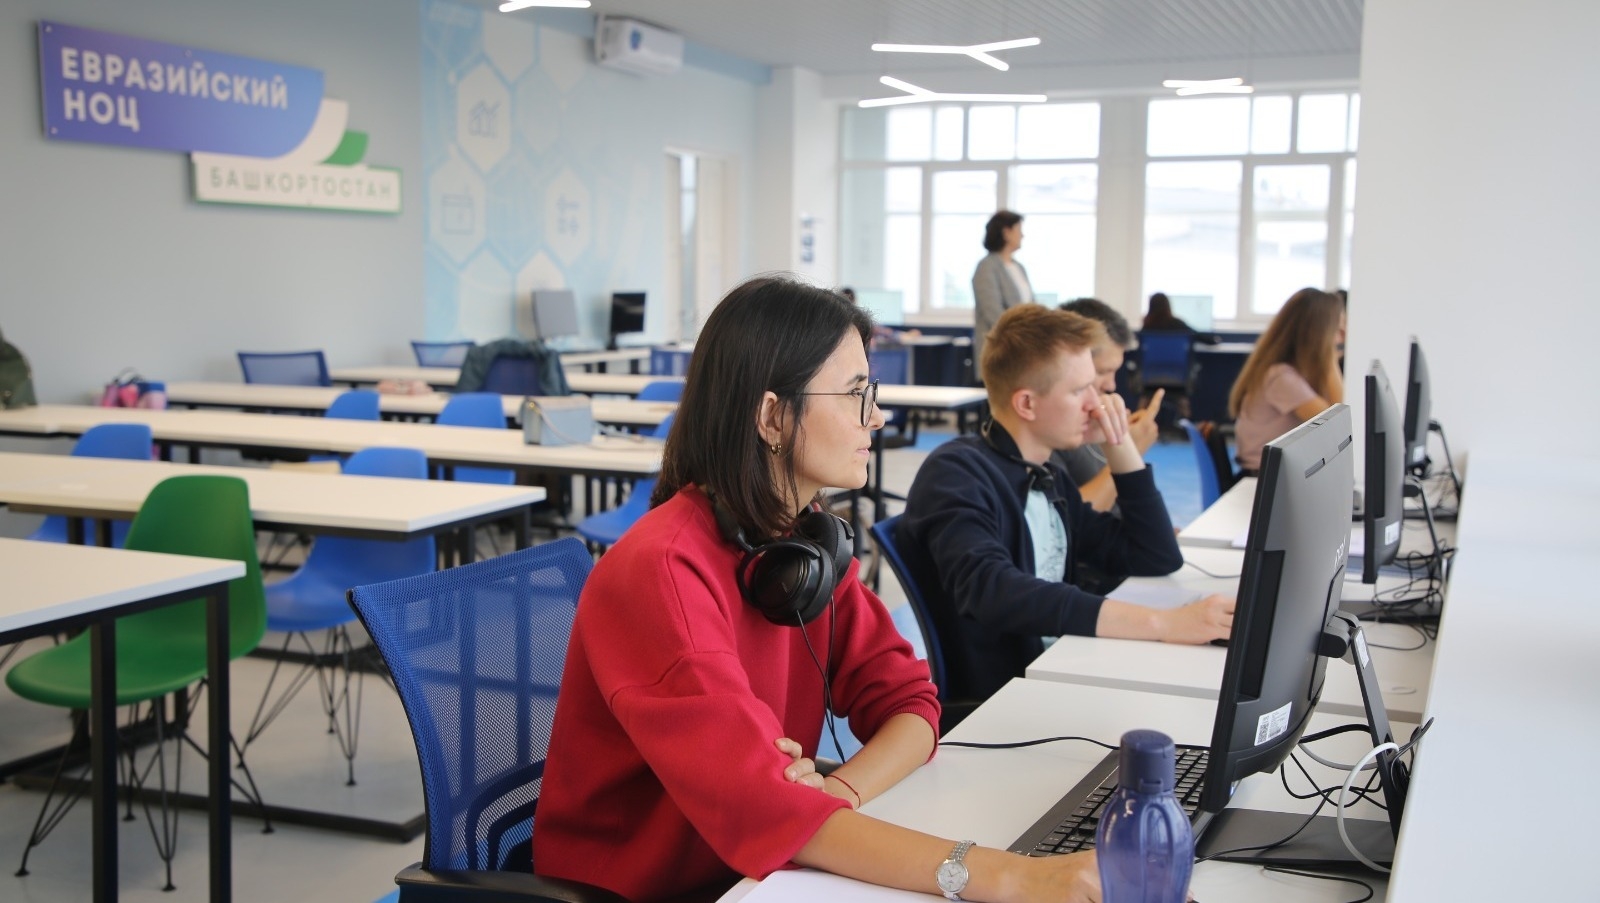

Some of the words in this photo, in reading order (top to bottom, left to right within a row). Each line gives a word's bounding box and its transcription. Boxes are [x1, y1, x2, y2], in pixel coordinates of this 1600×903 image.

[61, 47, 288, 110] ЕВРАЗИЙСКИЙ
[63, 88, 140, 132] НОЦ
[210, 166, 392, 199] БАШКОРТОСТАН
